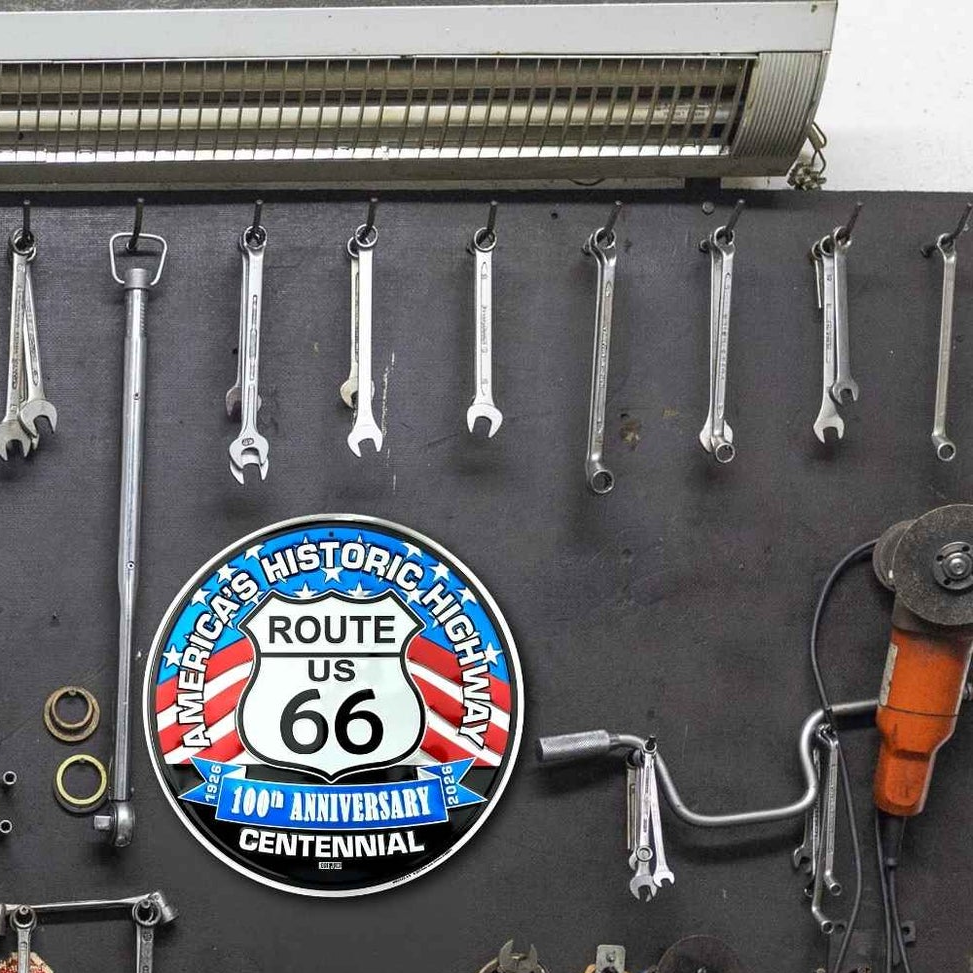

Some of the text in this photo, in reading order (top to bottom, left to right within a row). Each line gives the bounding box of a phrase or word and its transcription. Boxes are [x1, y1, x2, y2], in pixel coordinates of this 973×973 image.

[177, 541, 492, 750] AMERICA'S HISTORIC HIGHWAY
[268, 615, 396, 644] ROUTE
[308, 659, 356, 682] US
[279, 688, 384, 755] 66
[204, 764, 222, 802] 1926
[441, 765, 459, 805] 2026
[231, 785, 431, 822] 100th ANNIVERSARY
[238, 828, 425, 858] CENTENNIAL
